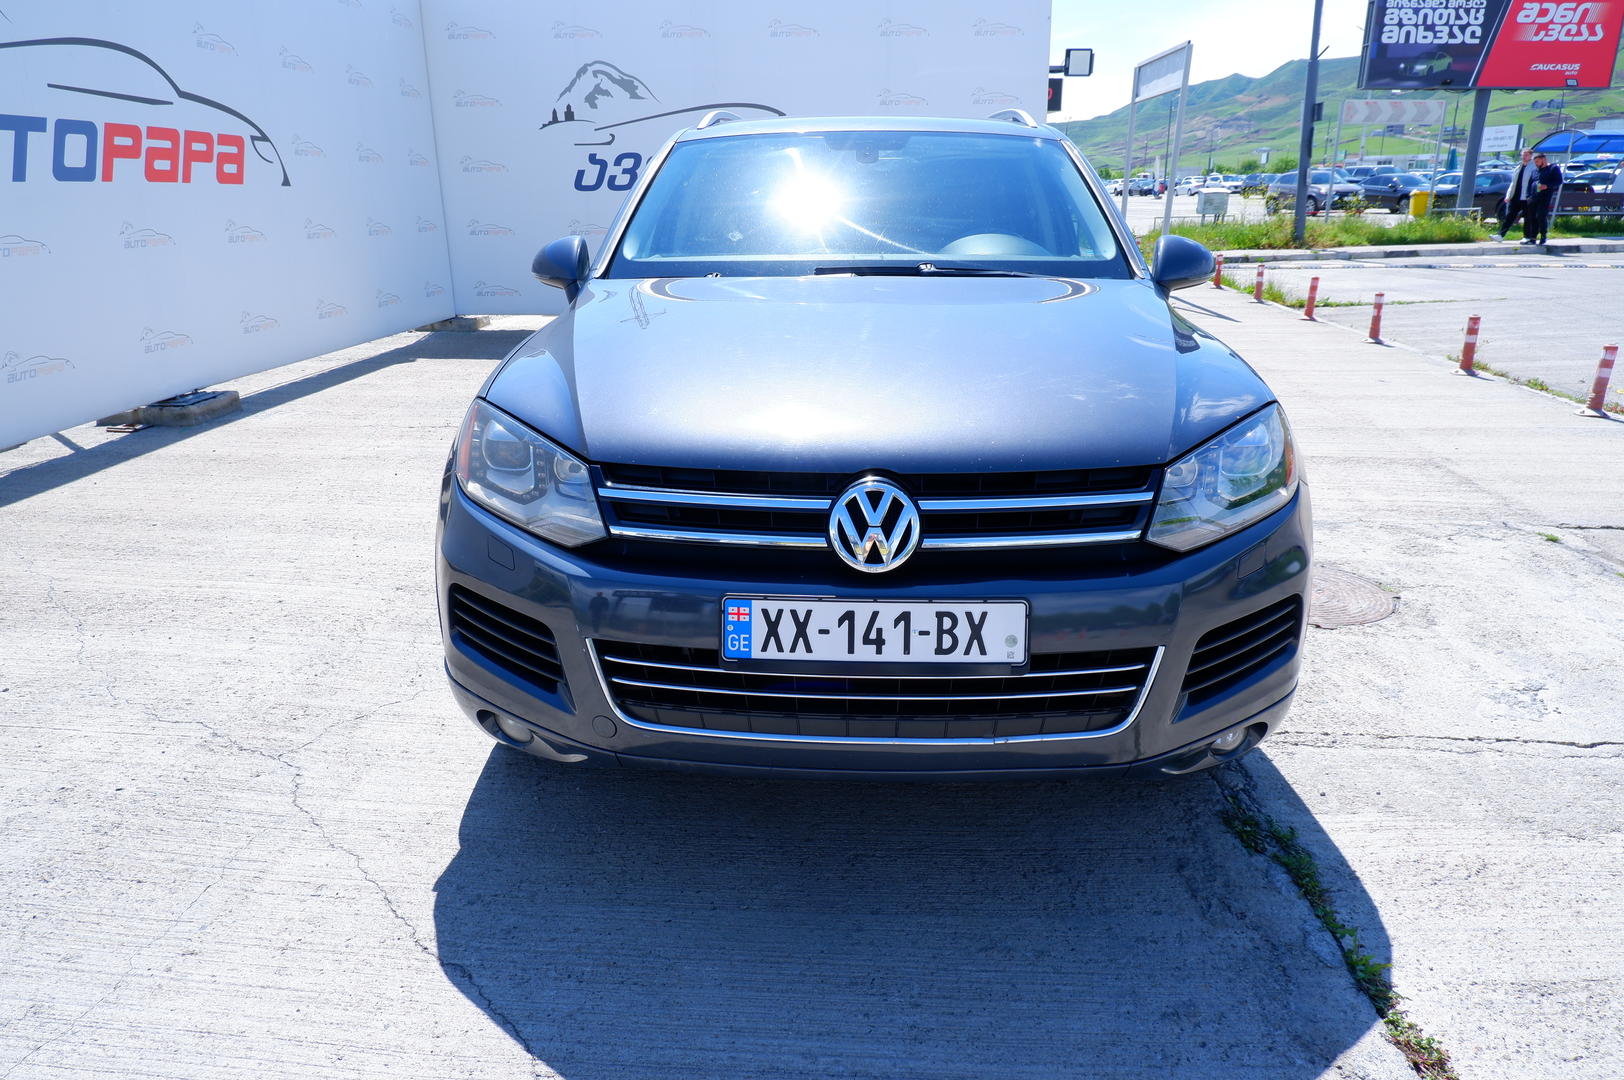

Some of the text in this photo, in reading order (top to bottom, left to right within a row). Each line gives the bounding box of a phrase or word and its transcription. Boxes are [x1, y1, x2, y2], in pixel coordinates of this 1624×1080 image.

[1384, 8, 1486, 25] გზითაც
[1381, 25, 1482, 44] მიხვალ
[1529, 63, 1581, 71] CAUCASUS
[574, 152, 650, 191] ავ
[832, 482, 917, 570] VW
[760, 608, 989, 656] XX-141-BX
[727, 634, 749, 651] GE
